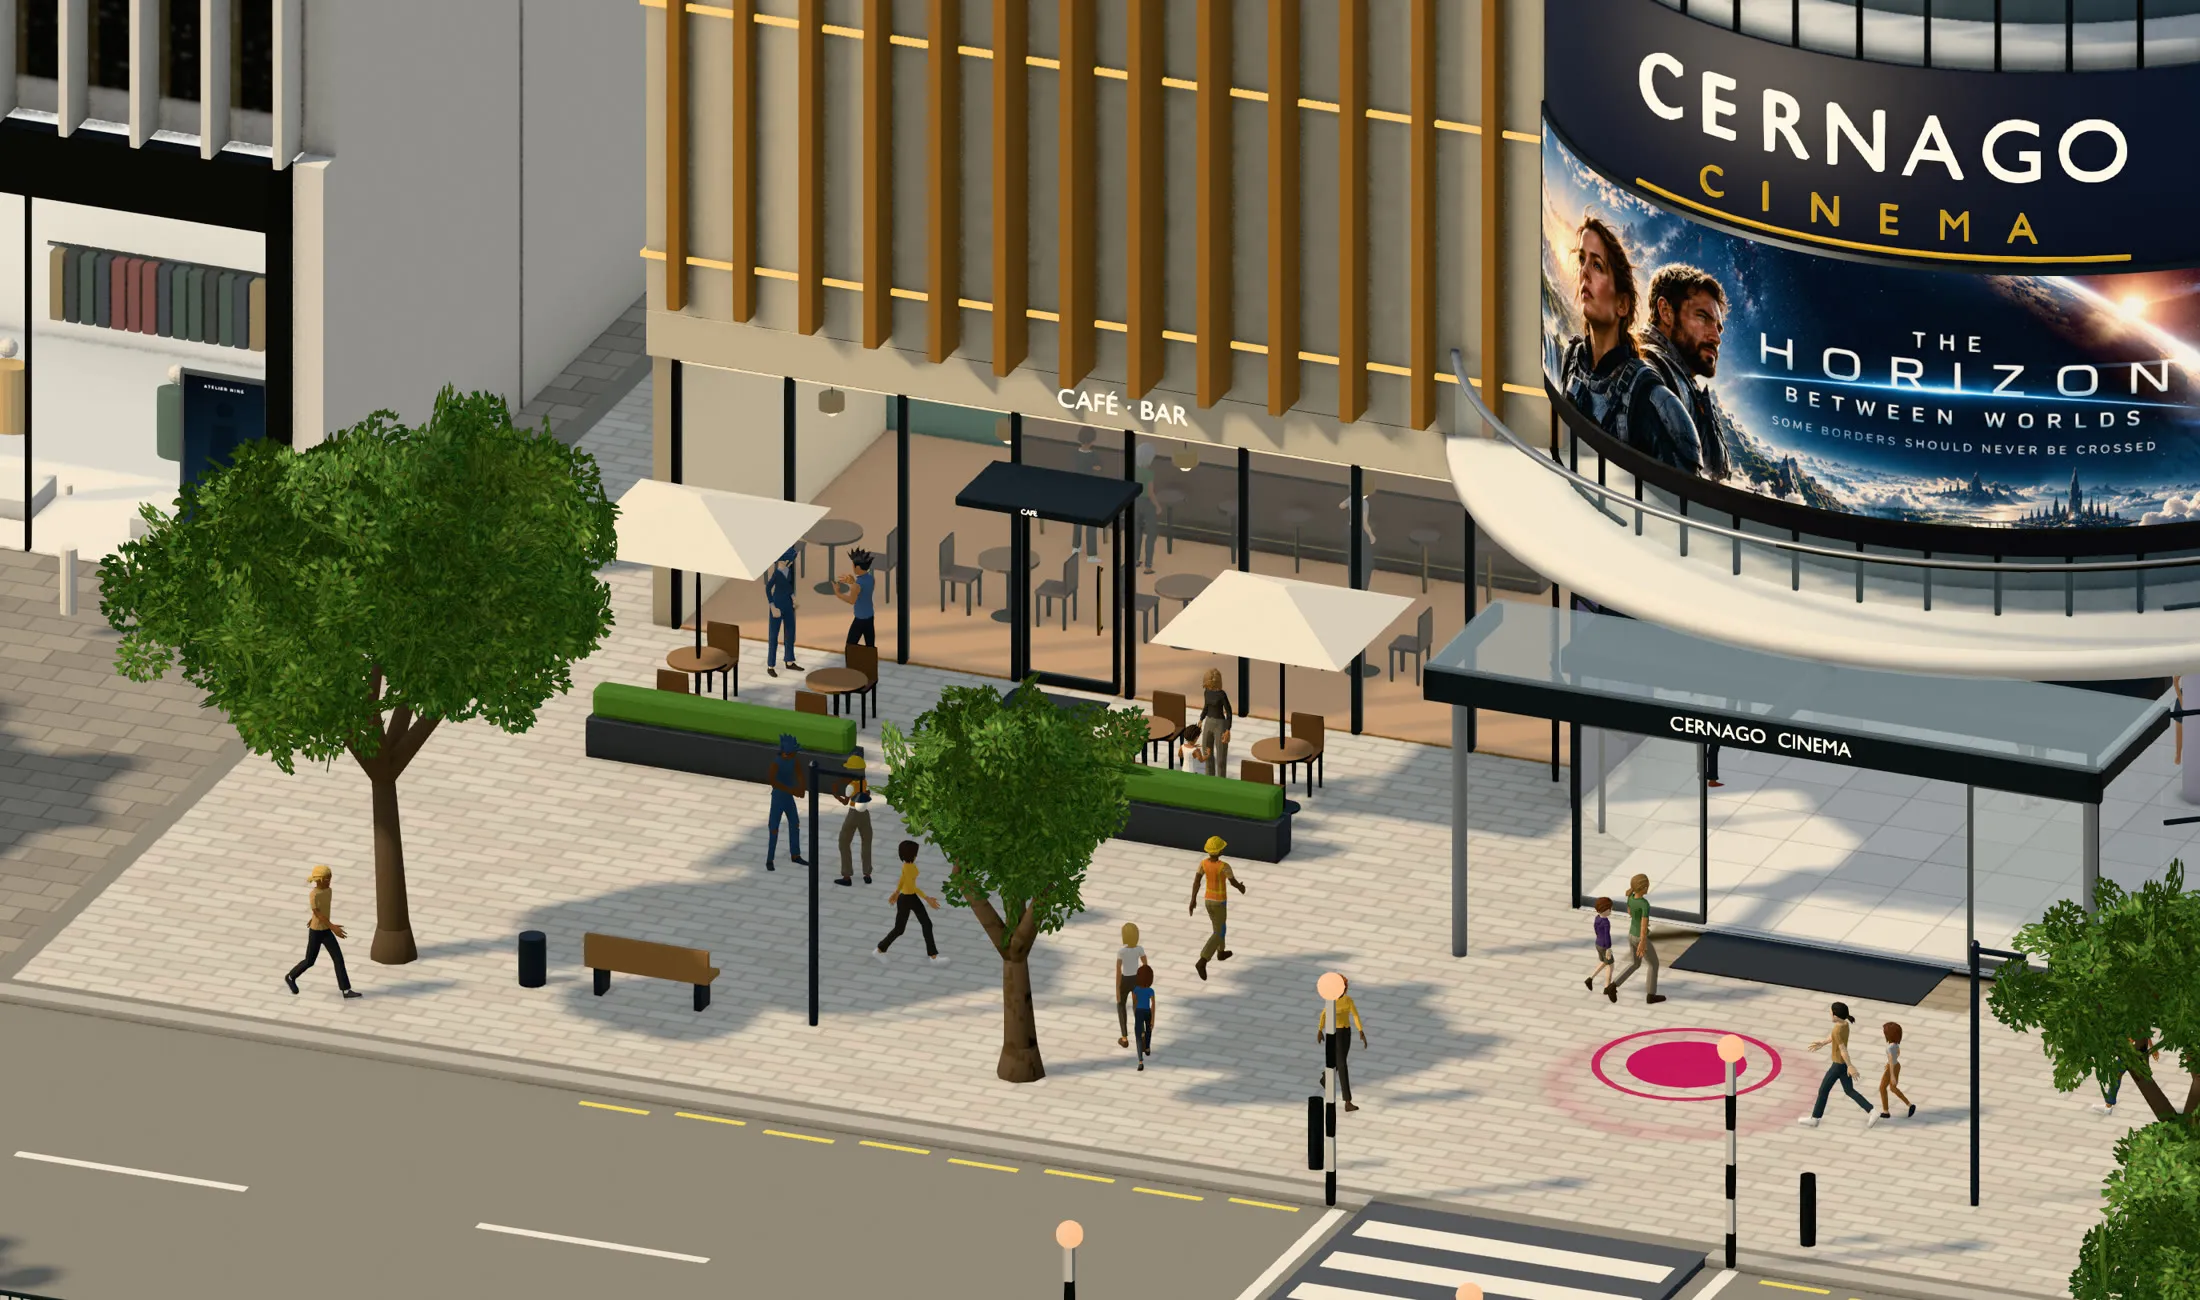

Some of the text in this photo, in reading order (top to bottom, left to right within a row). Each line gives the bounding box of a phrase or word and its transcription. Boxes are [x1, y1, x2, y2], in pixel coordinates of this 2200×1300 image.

[1637, 52, 2129, 184] CERNAGO
[1699, 164, 2039, 245] CINEMA
[1912, 331, 1982, 354] THE
[1760, 332, 2171, 397] HORIZON
[1057, 388, 1119, 416] CAFÉ
[1140, 400, 1189, 427] BAR
[1784, 386, 2141, 429] BETWEEN WORLDS
[1772, 415, 2157, 456] SOME BORDERS SHOULD NEVER BE CROSSED
[1669, 716, 1852, 759] CERNAGO CINEMA
